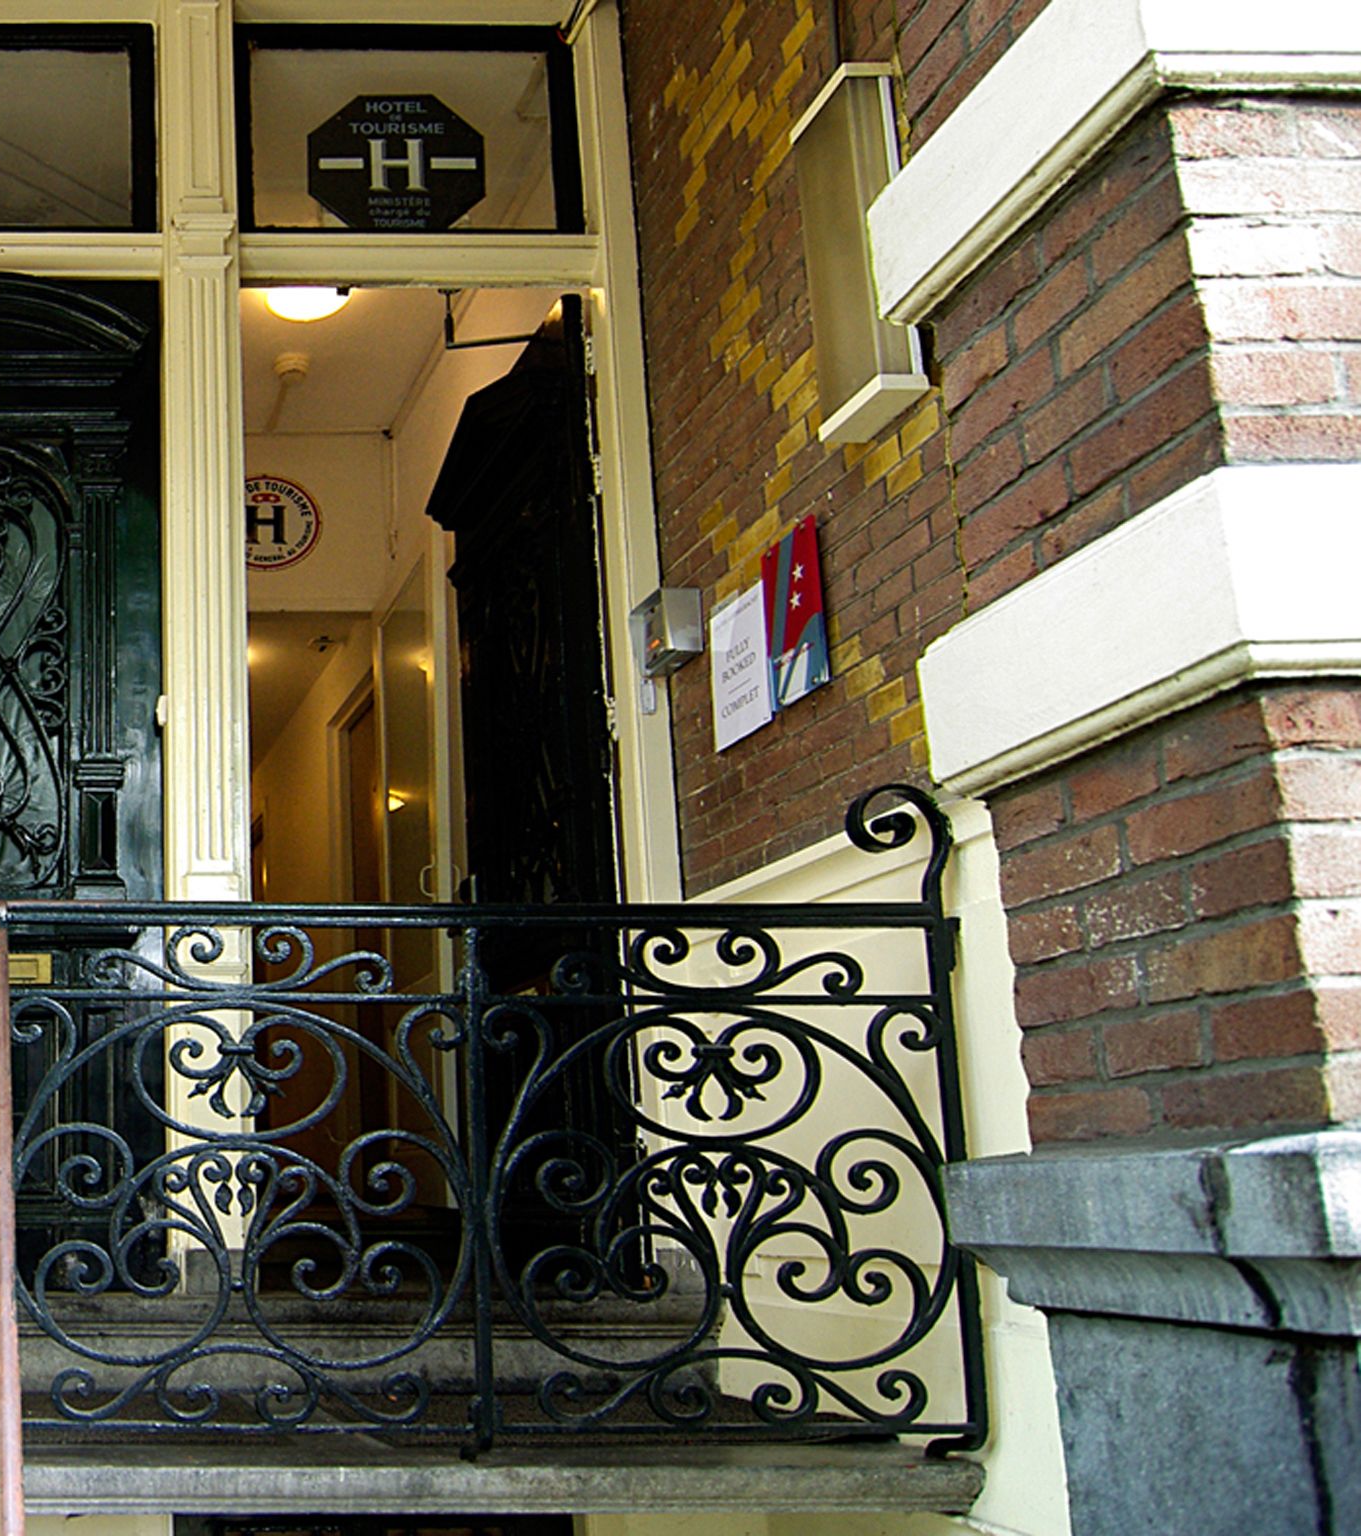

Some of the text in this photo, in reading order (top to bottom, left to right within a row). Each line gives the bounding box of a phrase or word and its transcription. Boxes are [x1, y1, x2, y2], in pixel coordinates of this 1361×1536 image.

[365, 101, 427, 113] HOTEL
[348, 122, 445, 135] TOURISME
[368, 138, 428, 191] H
[373, 218, 426, 228] TOURISME
[415, 207, 431, 216] du
[264, 481, 313, 517] TOURISME
[245, 505, 288, 545] H
[725, 635, 751, 664] FULLY
[721, 651, 757, 684] BOOKED
[721, 685, 761, 719] COMPLET
